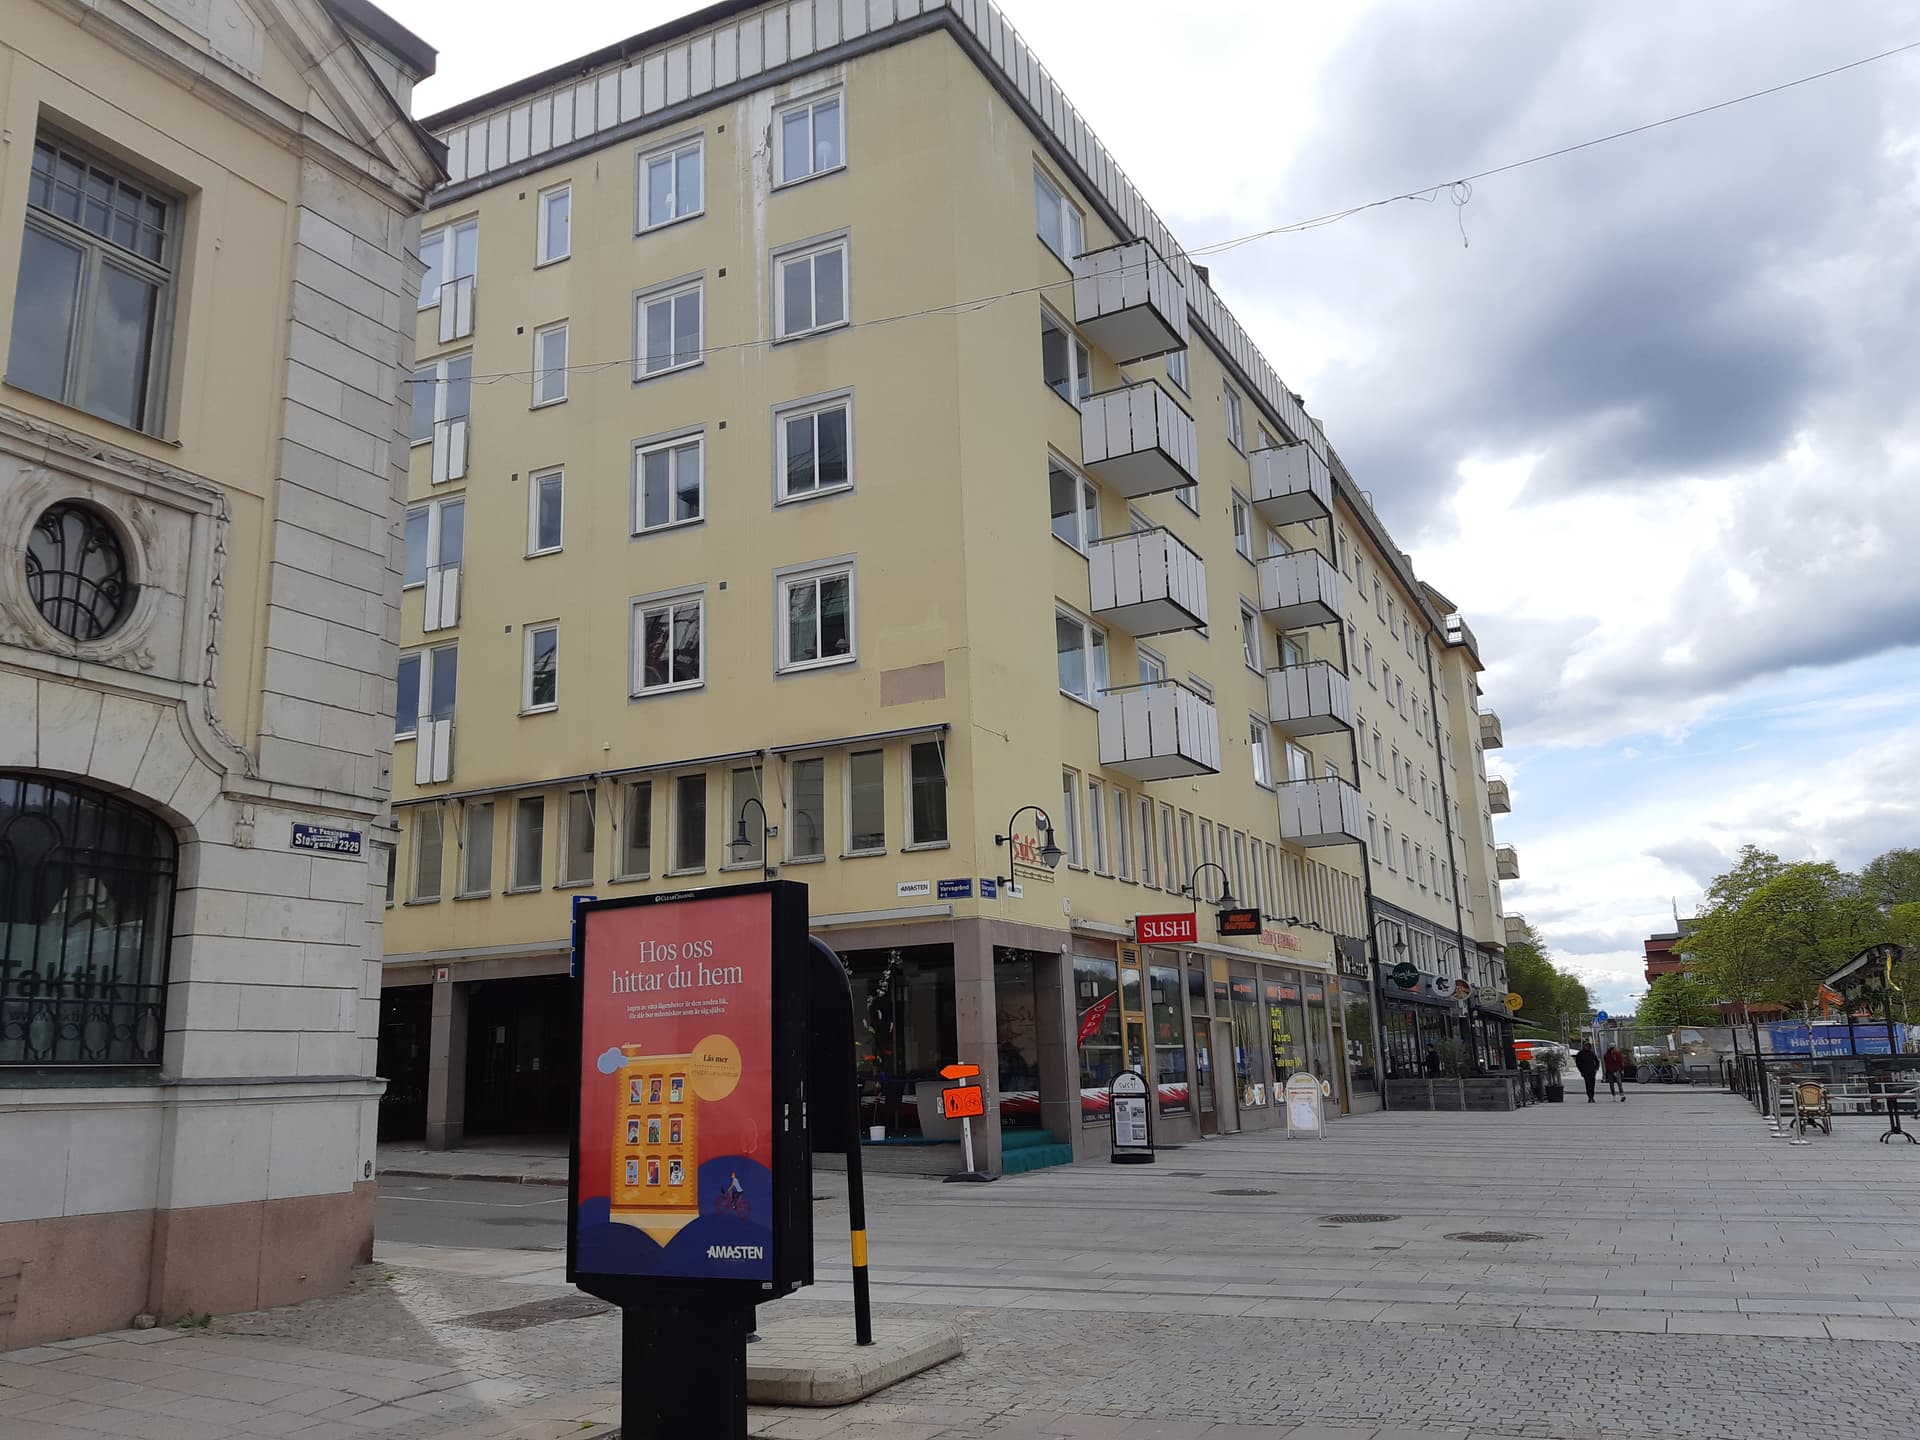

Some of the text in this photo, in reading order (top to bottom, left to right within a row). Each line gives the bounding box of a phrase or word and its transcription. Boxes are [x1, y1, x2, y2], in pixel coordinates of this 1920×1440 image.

[339, 840, 359, 852] 23-29
[901, 884, 928, 892] AMASTEN
[1143, 920, 1191, 939] SUSHI
[639, 939, 713, 964] Hos oss
[611, 963, 744, 994] hittar du hem
[706, 1245, 763, 1260] AMASTEN
